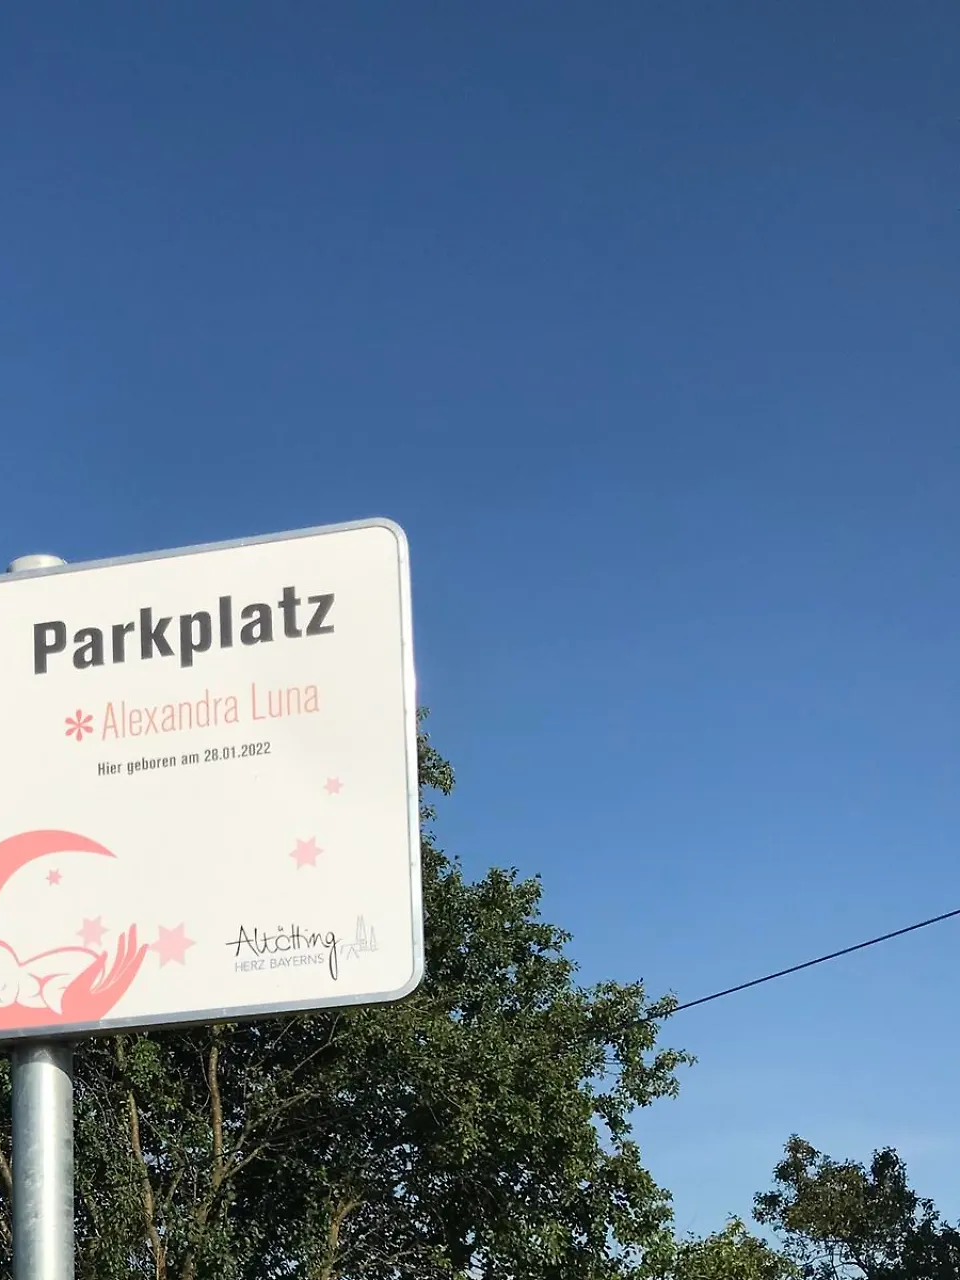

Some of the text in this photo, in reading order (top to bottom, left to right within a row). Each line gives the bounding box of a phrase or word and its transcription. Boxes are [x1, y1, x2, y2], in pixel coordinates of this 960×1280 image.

[33, 586, 336, 675] Parkplatz
[101, 681, 321, 742] Alexandra Luna
[97, 741, 272, 776] Hier geboren am 28.01.2022
[225, 924, 343, 981] Altötting
[234, 953, 325, 974] HERZ BAYERNS
